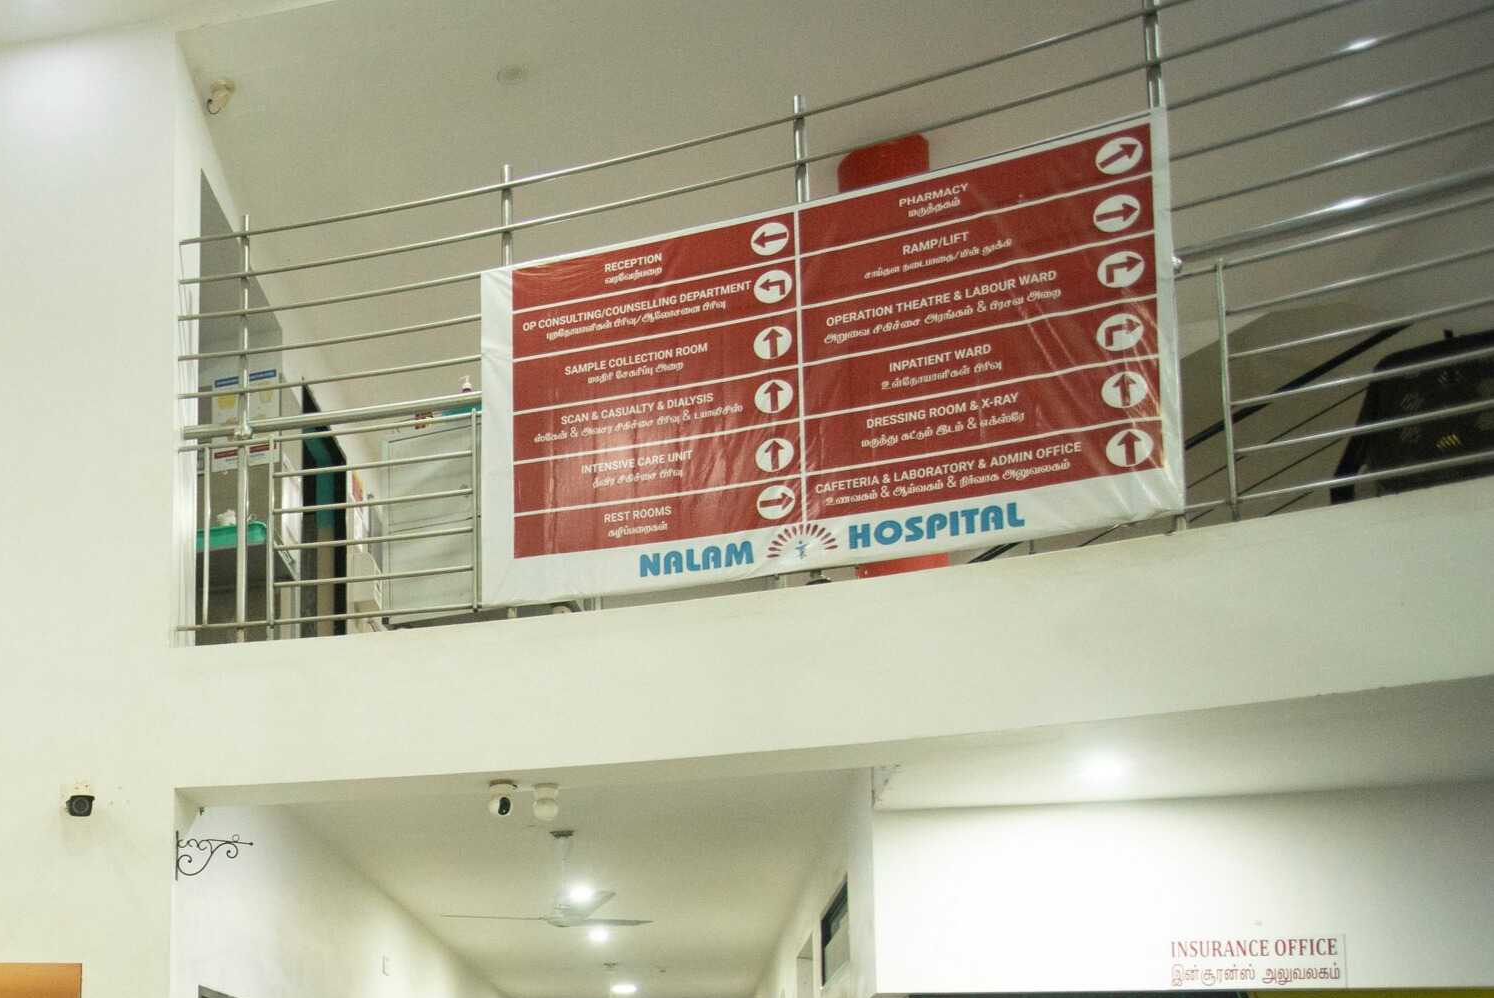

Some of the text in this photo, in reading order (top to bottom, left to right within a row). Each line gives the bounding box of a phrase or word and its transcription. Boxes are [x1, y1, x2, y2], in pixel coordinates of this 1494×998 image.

[899, 183, 968, 207] PHARMACY
[902, 232, 969, 255] RAMP/LIFT
[604, 253, 662, 272] RECEPTION
[522, 280, 752, 332] OP CONSULTING/COUNSELLING DEPARTMENT
[826, 270, 1057, 326] OPERATION THEATRE & LABOUR WARD
[976, 300, 987, 312] &
[564, 342, 708, 376] SAMPLE COLLECTION ROOM
[890, 344, 992, 372] INPATIENT WARD
[560, 392, 714, 425] SCAN & CASUALTY & DIALYSIS
[866, 392, 1018, 429] DRESSING ROOM & X-RAY
[570, 427, 578, 438] &
[682, 410, 690, 421] &
[967, 418, 976, 430] &
[582, 450, 694, 474] INTENSIVE CARE UNIT
[816, 442, 1082, 494] CAFETERIA & LABORATORY & ADMIN OFFICE
[880, 486, 890, 498] &
[947, 476, 957, 488] &
[604, 506, 672, 523] REST ROOMS
[640, 502, 1026, 578] NALAM HOSPITAL
[1170, 938, 1338, 958] INSURANCE OFFICE
